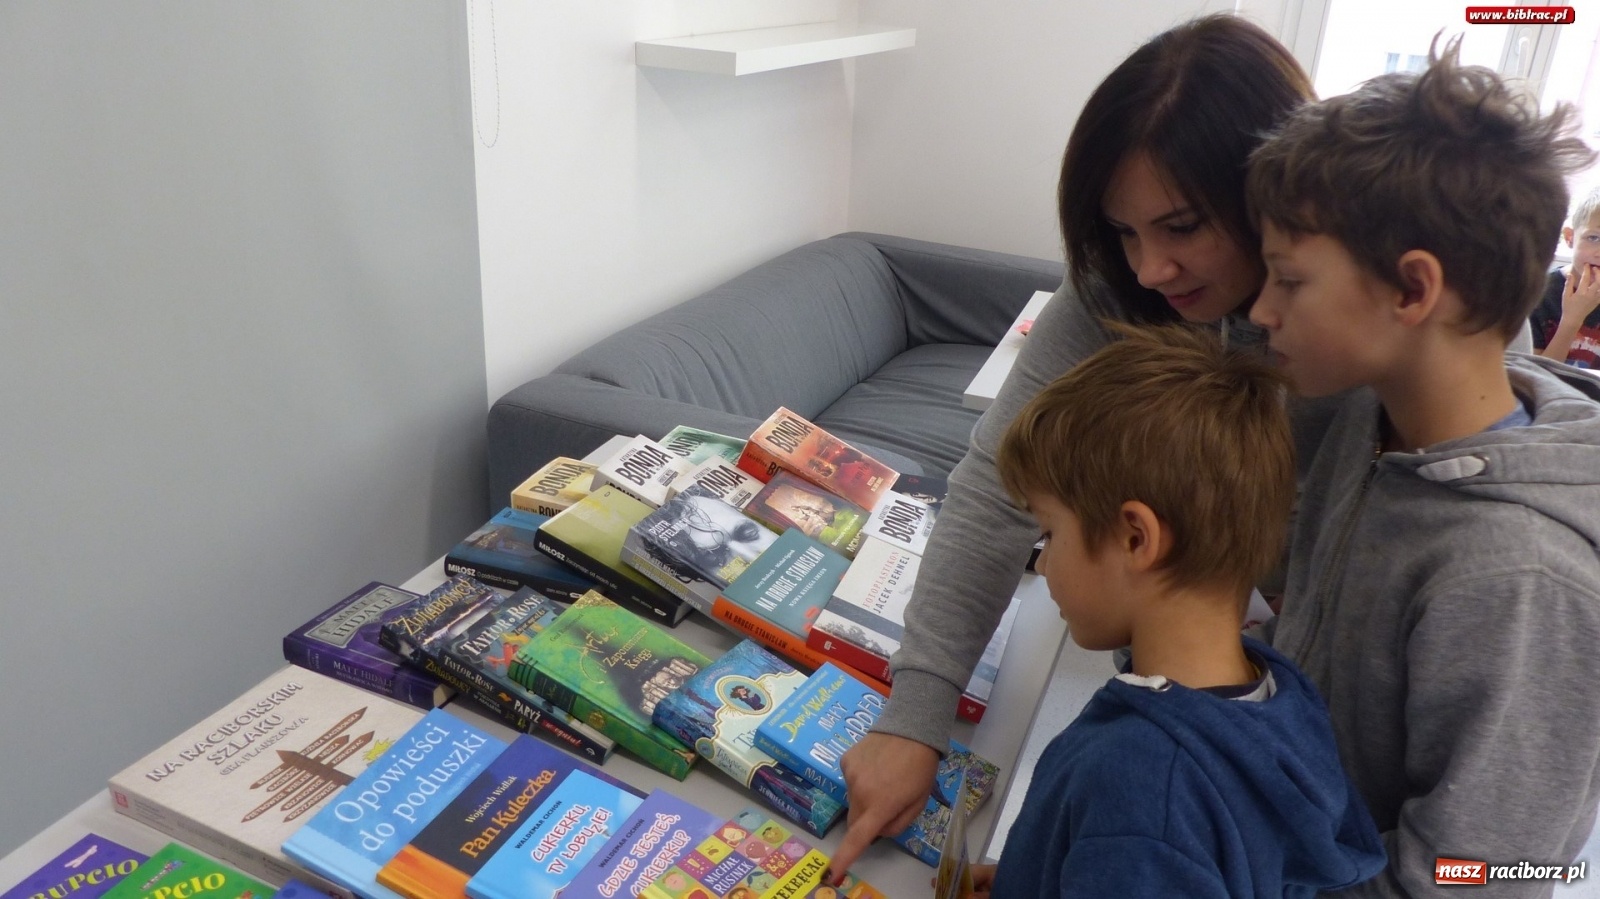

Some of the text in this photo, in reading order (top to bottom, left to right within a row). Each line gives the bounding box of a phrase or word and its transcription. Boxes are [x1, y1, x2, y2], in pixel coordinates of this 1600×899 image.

[765, 416, 814, 454] BONDA
[529, 463, 591, 496] BONDA
[615, 445, 673, 486] BONDA
[697, 465, 748, 499] ONDA
[649, 520, 671, 535] PIOTR
[659, 518, 689, 541] STELMACH
[879, 499, 926, 544] BONDA
[448, 563, 476, 577] MIŁOSZ
[539, 541, 565, 561] MIŁOSZ
[755, 545, 825, 612] NA DRUGIE STANISŁAW
[862, 552, 899, 608] FOTOPLASTIKON
[873, 556, 910, 614] JACEK DEHNEL
[333, 597, 396, 637] HIDALF
[460, 617, 505, 655] TAYLOR
[507, 594, 545, 620] ROSE
[724, 610, 734, 619] NA
[733, 614, 754, 632] DRUGIE
[754, 627, 788, 649] STANISŁAW
[443, 655, 472, 681] TAYLOR
[474, 674, 494, 692] ROSE
[324, 713, 360, 740] RACIBORSKA
[514, 699, 542, 724] PARYŻ
[780, 703, 815, 743] David
[818, 701, 848, 731] MAŁY
[146, 760, 184, 783] NA
[181, 681, 304, 761] RACIBORSKIM
[208, 713, 284, 766] SZLAKU
[220, 716, 310, 776] GRA PLANSZOWA
[332, 739, 364, 765] KORNOWAC
[334, 722, 450, 823] Opowieści
[361, 821, 396, 852] do
[393, 729, 488, 824] poduszki
[804, 767, 838, 794] MAŁY
[246, 773, 313, 820] PIETROWICE WIELKIE
[459, 824, 502, 858] Pan
[498, 767, 557, 831] Kuleczka
[465, 796, 497, 823] Wojciech
[515, 818, 545, 849] WALDEMAR
[532, 804, 592, 862] CUKIERKU,
[547, 807, 613, 875] TY ŁOBUZIE!
[598, 838, 628, 868] WALDEMAR
[704, 856, 740, 885] MICHAŁ
[598, 856, 638, 898] GDZIE
[713, 861, 754, 894] RUSINEK
